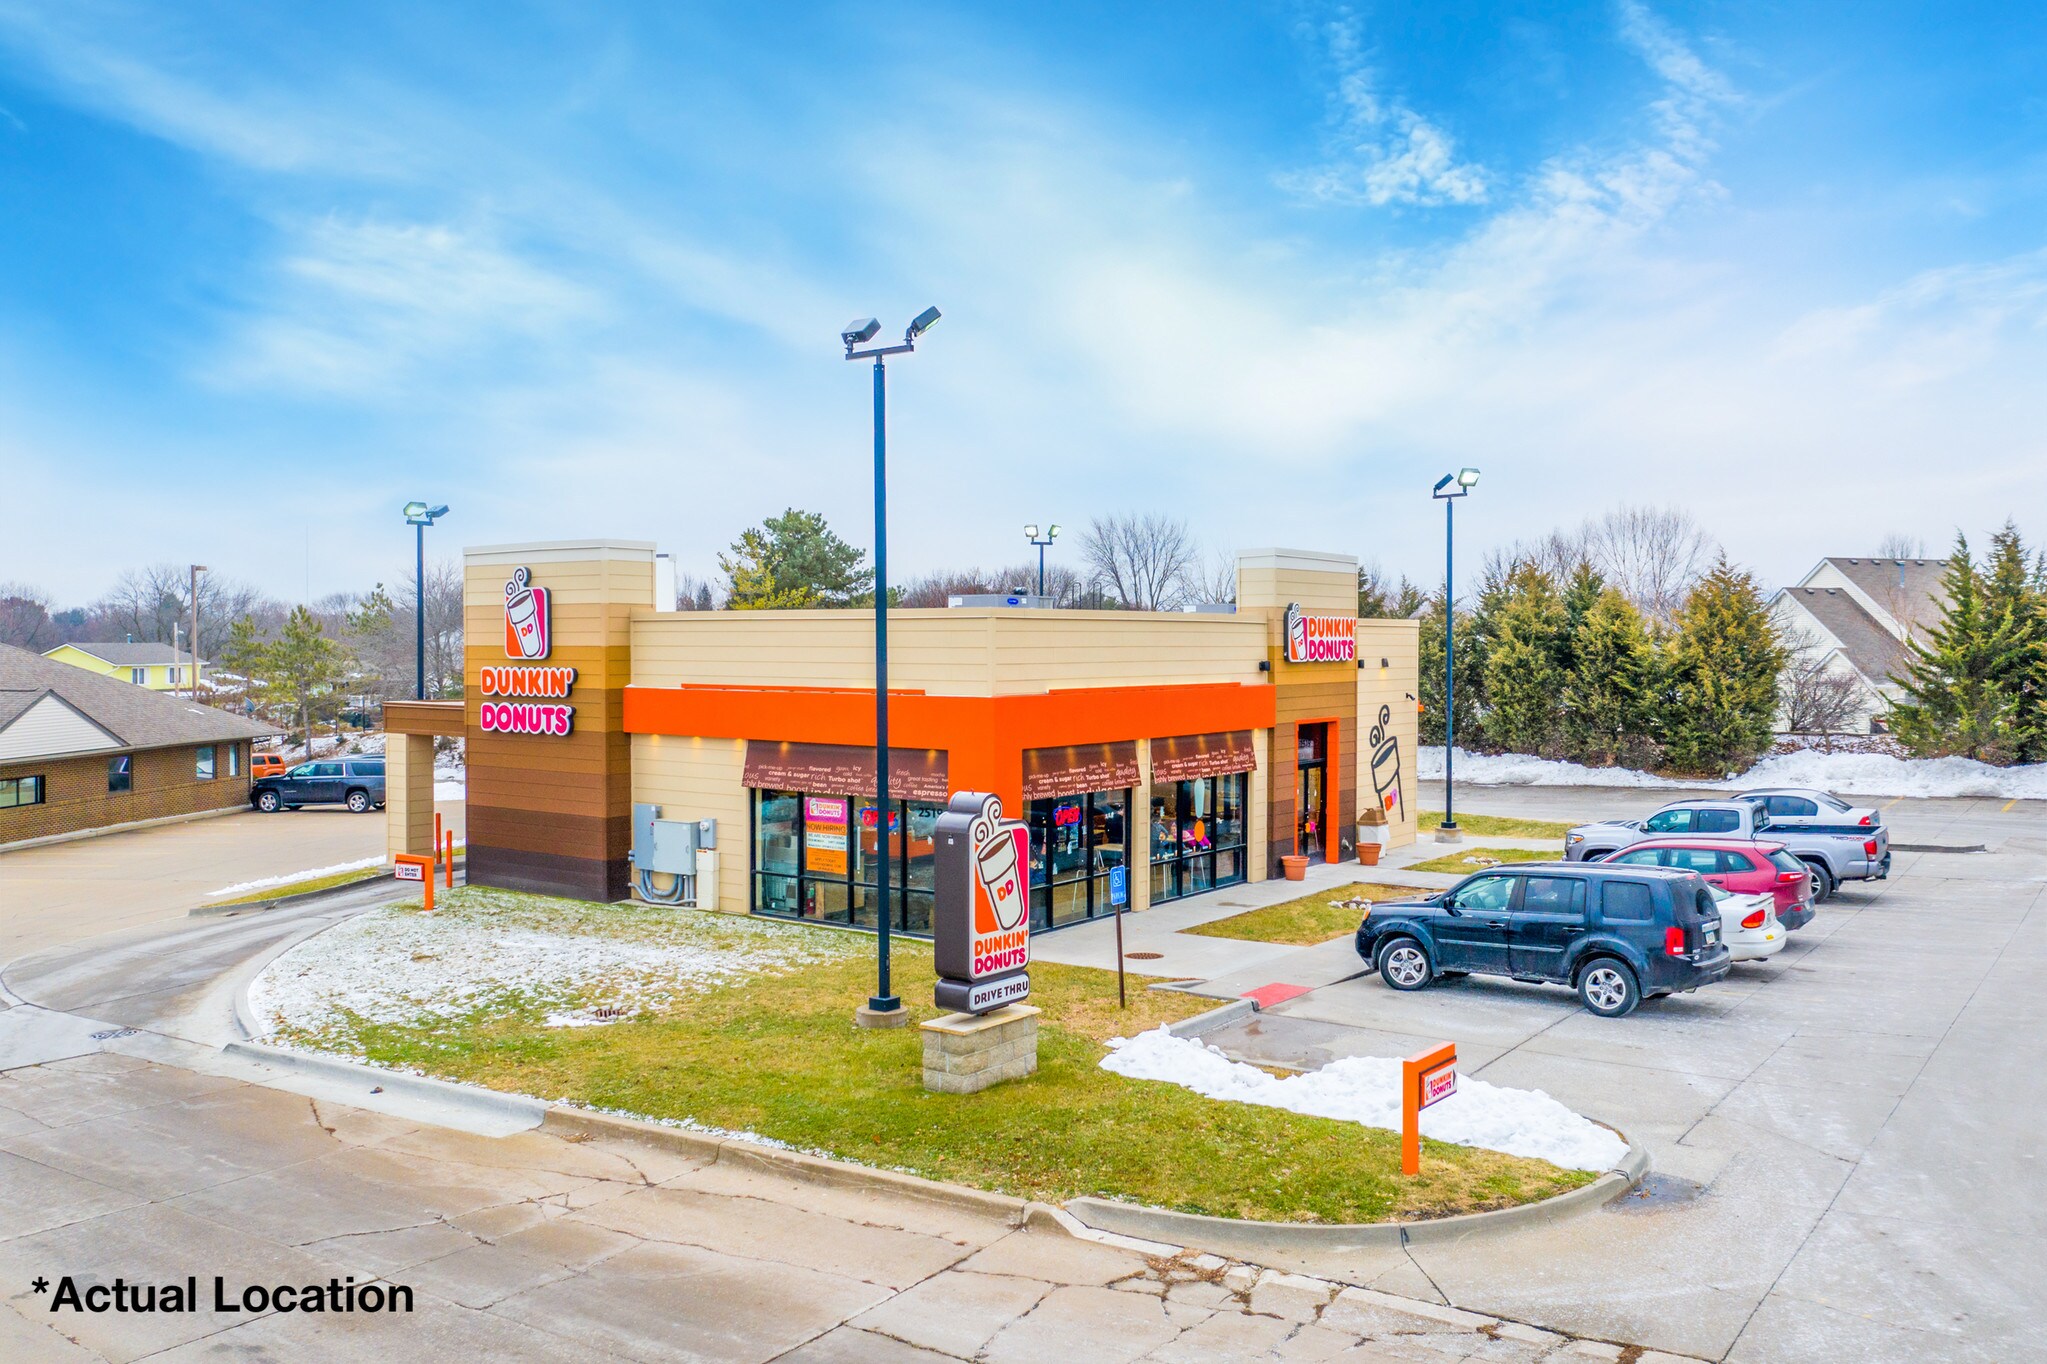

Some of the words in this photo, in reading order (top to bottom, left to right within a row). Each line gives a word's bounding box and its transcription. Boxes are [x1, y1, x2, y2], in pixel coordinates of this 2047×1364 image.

[521, 623, 533, 637] DD
[1308, 617, 1357, 638] DUNKIN'
[1308, 639, 1354, 660] DONUTS
[481, 668, 573, 697] DUNKIN'
[481, 704, 569, 735] DONUTS
[793, 771, 810, 779] sugar
[810, 772, 826, 781] rich
[828, 775, 846, 783] Turbo
[757, 780, 784, 790] brewed
[912, 789, 948, 797] espresso
[1055, 807, 1080, 826] OPEN
[806, 823, 822, 831] NOW
[822, 824, 846, 834] HIRING
[997, 879, 1014, 902] DD
[974, 929, 1028, 957] DUNKIN'
[974, 947, 1026, 975] DONUTS
[974, 987, 1002, 1005] DRIVE
[1003, 980, 1028, 997] THRU
[1432, 1080, 1452, 1097] DONUTS
